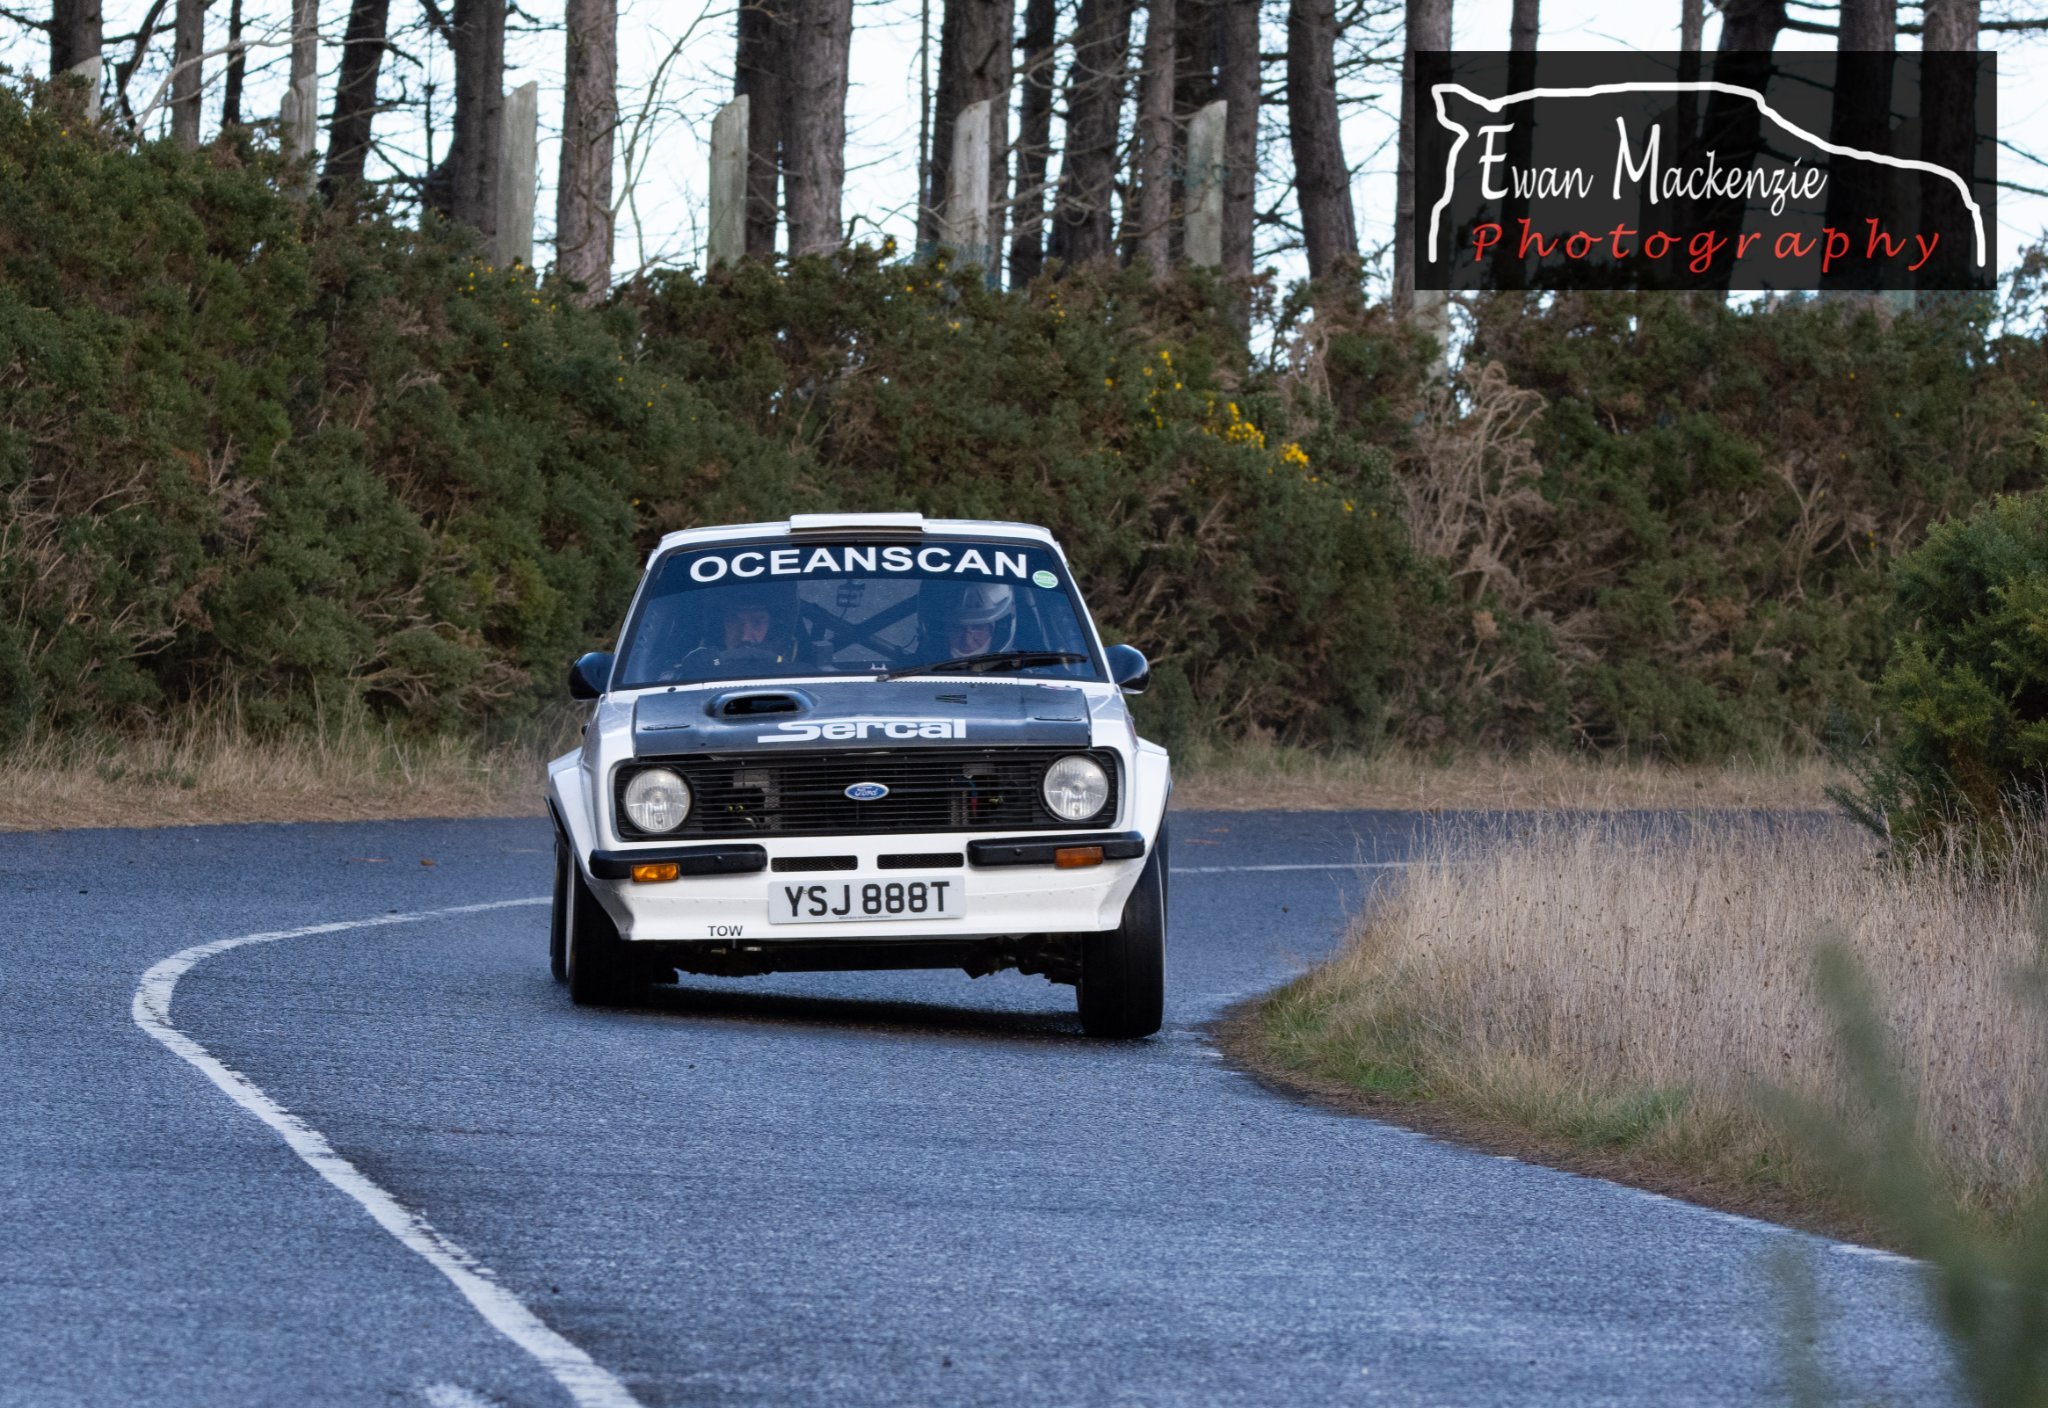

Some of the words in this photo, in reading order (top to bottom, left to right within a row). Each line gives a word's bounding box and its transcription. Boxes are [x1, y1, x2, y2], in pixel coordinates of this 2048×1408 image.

[689, 546, 1028, 583] OCEANSCAN
[757, 718, 968, 744] Sercal
[854, 785, 880, 797] Ford
[784, 884, 851, 918] YSJ
[861, 880, 951, 915] 888T
[707, 924, 744, 937] TOW
